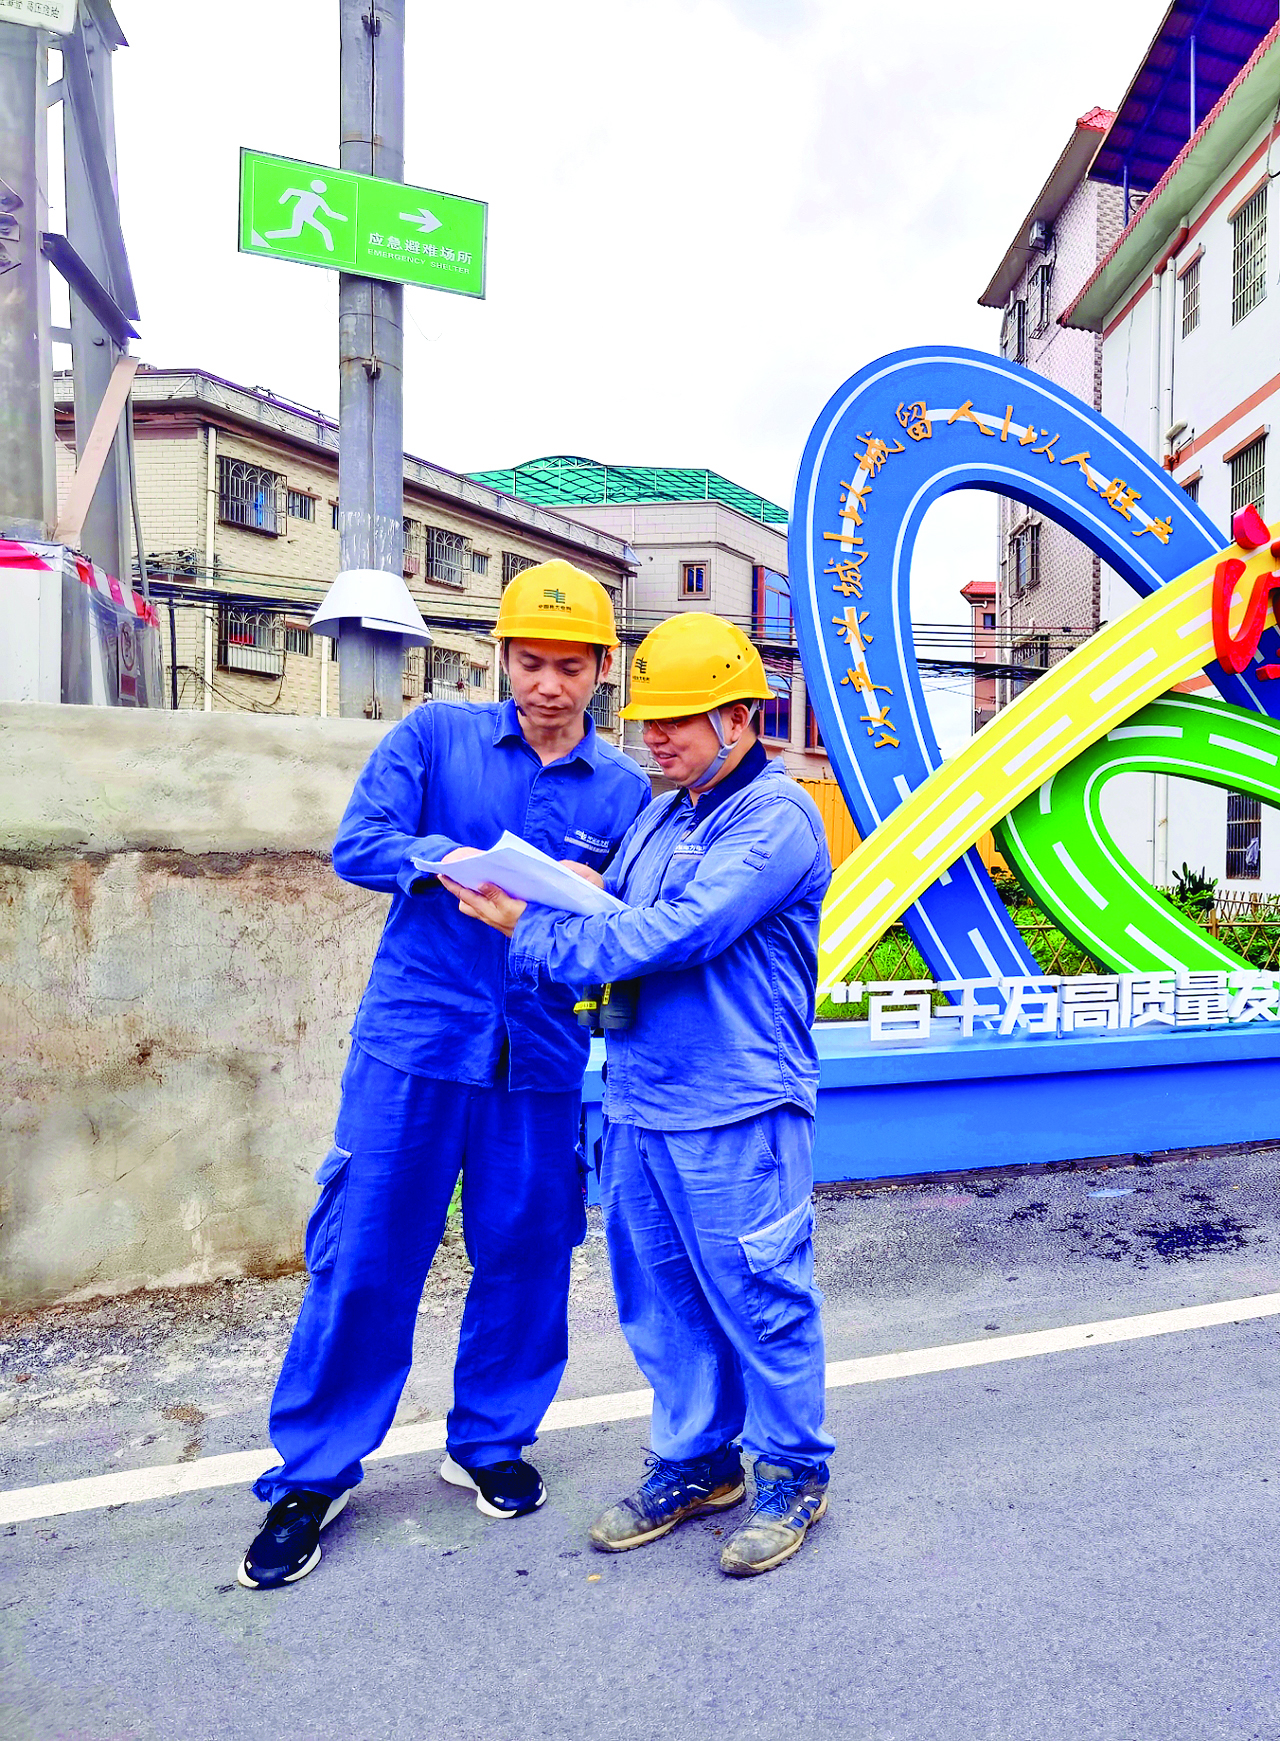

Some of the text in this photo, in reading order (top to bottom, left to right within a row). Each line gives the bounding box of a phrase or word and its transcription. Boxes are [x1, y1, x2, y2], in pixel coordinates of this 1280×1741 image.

[367, 248, 470, 275] EMERGENCY SHELTER
[368, 232, 473, 265] 应急避难场所
